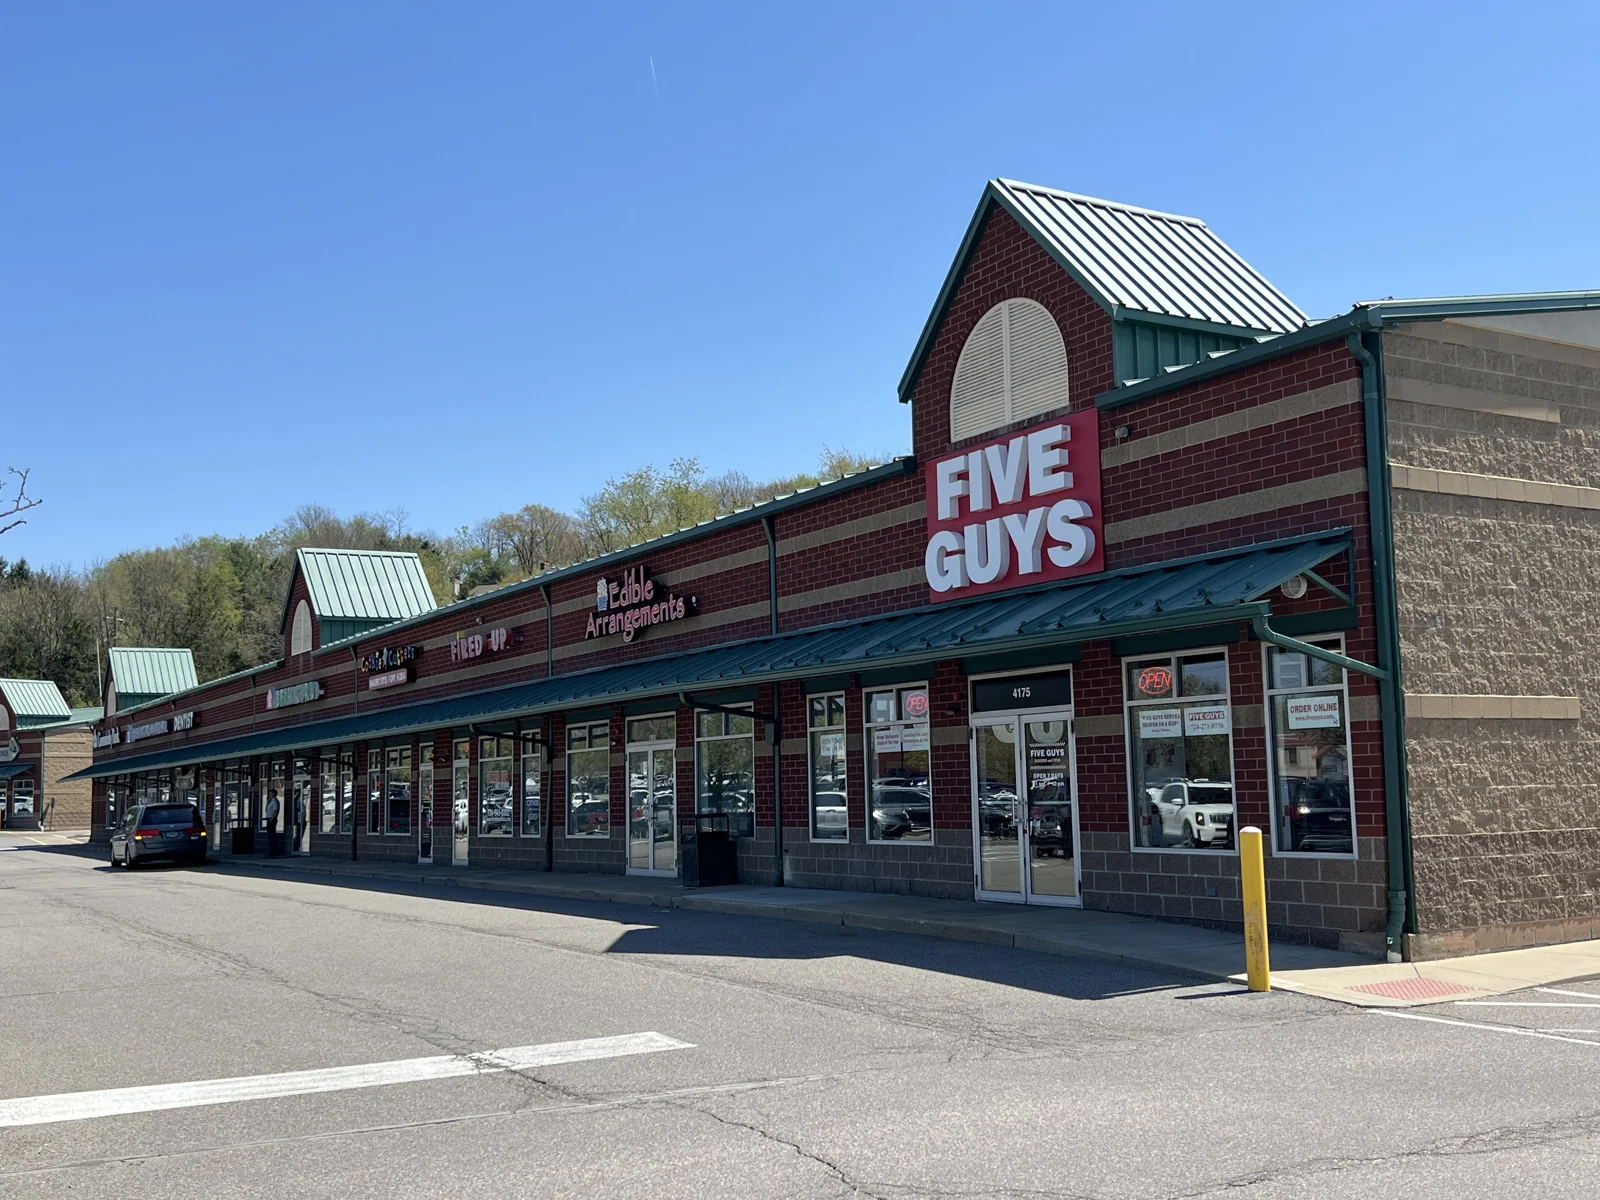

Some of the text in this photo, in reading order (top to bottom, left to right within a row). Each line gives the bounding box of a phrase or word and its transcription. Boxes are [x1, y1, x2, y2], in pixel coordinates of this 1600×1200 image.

[937, 424, 1073, 520] FIVE
[925, 498, 1095, 592] GUYS
[608, 565, 655, 609] Edible
[585, 593, 686, 643] Arrangements
[450, 632, 483, 661] FIRED
[1138, 672, 1172, 689] OPEN
[1012, 687, 1031, 698] 4175
[906, 696, 929, 711] OPEN
[1290, 702, 1338, 714] ORDER ONLINE
[173, 711, 193, 731] DENTIST
[1189, 711, 1224, 721] FIVE GUYS
[1030, 748, 1065, 758] FIVE GUYS
